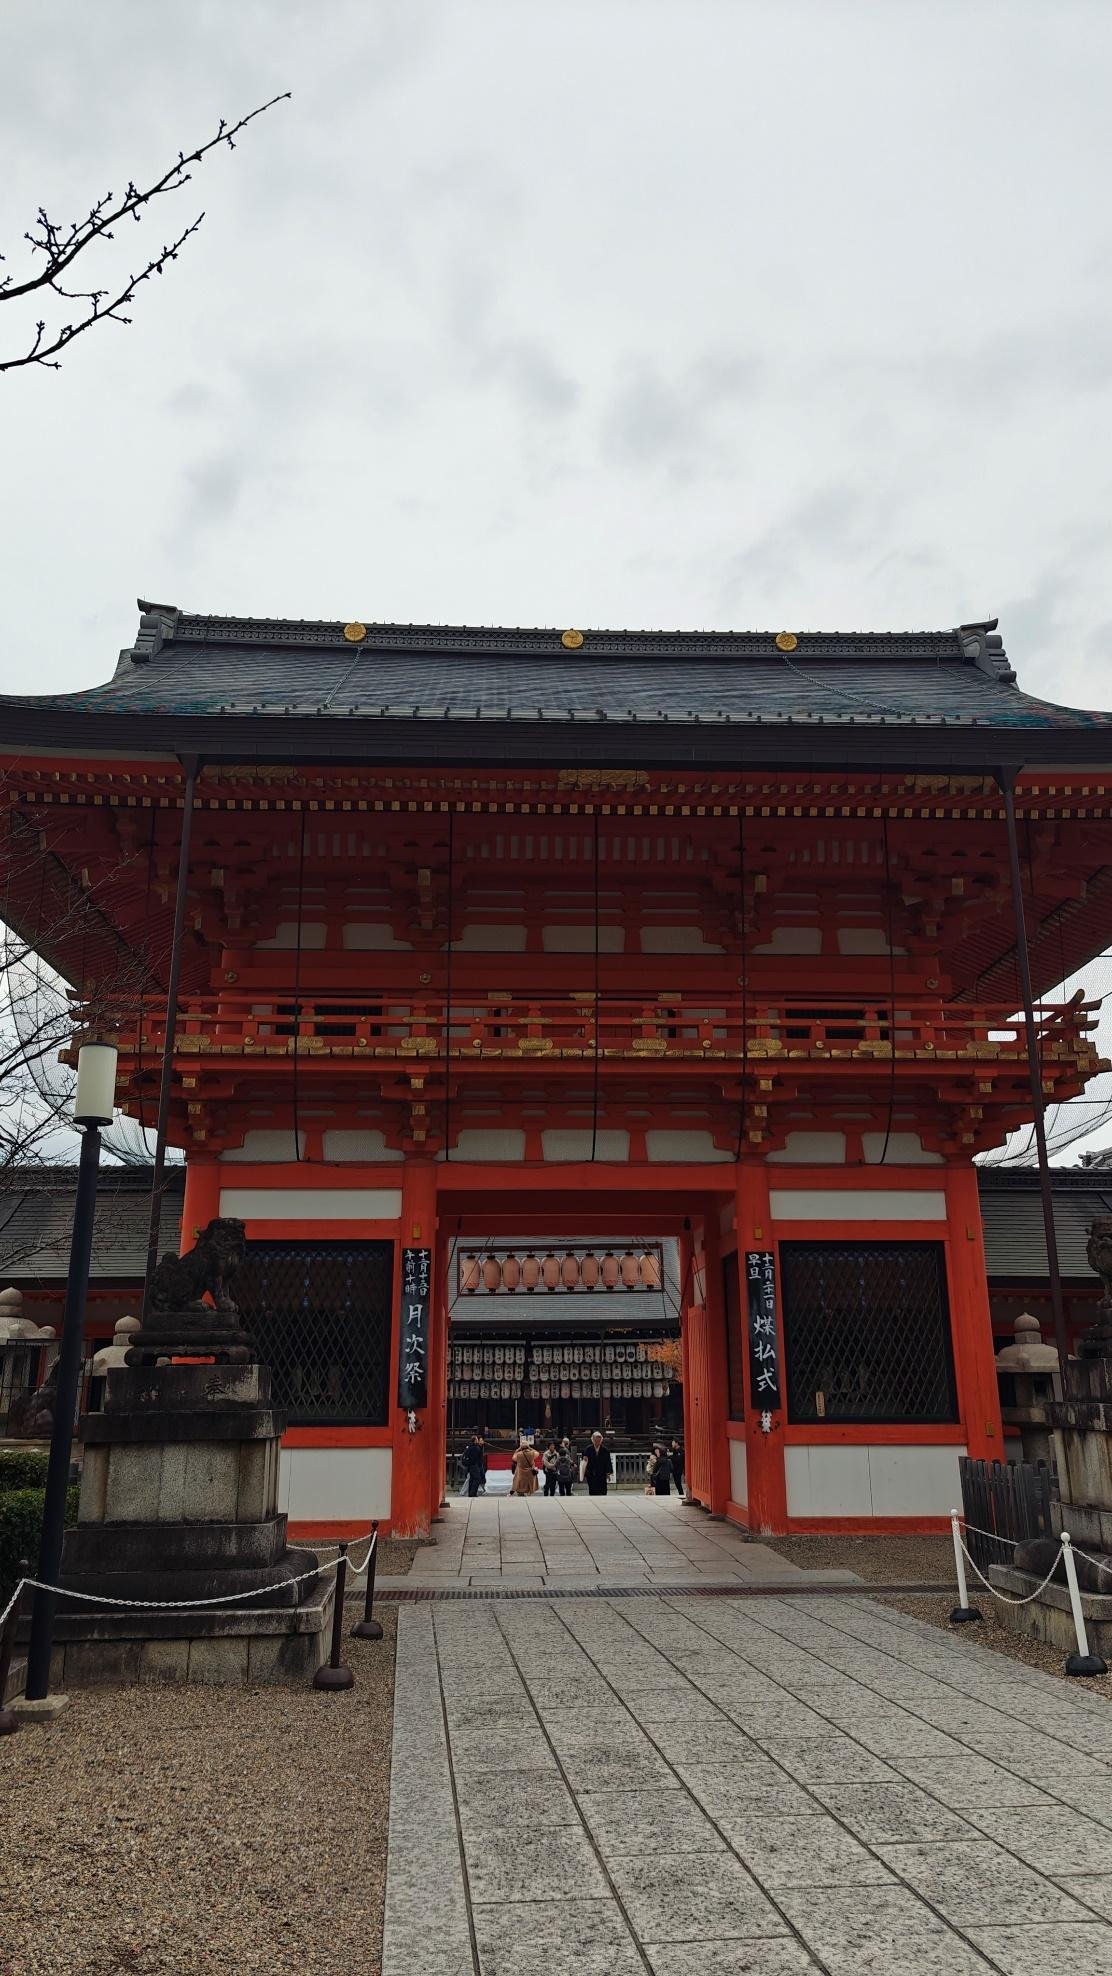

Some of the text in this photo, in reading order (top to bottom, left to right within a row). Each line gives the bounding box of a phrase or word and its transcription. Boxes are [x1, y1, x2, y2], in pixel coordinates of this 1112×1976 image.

[404, 1249, 417, 1296] 午前十時
[748, 1253, 761, 1279] 早旦
[404, 1303, 426, 1384] 月次祭
[753, 1314, 777, 1391] 煤払式
